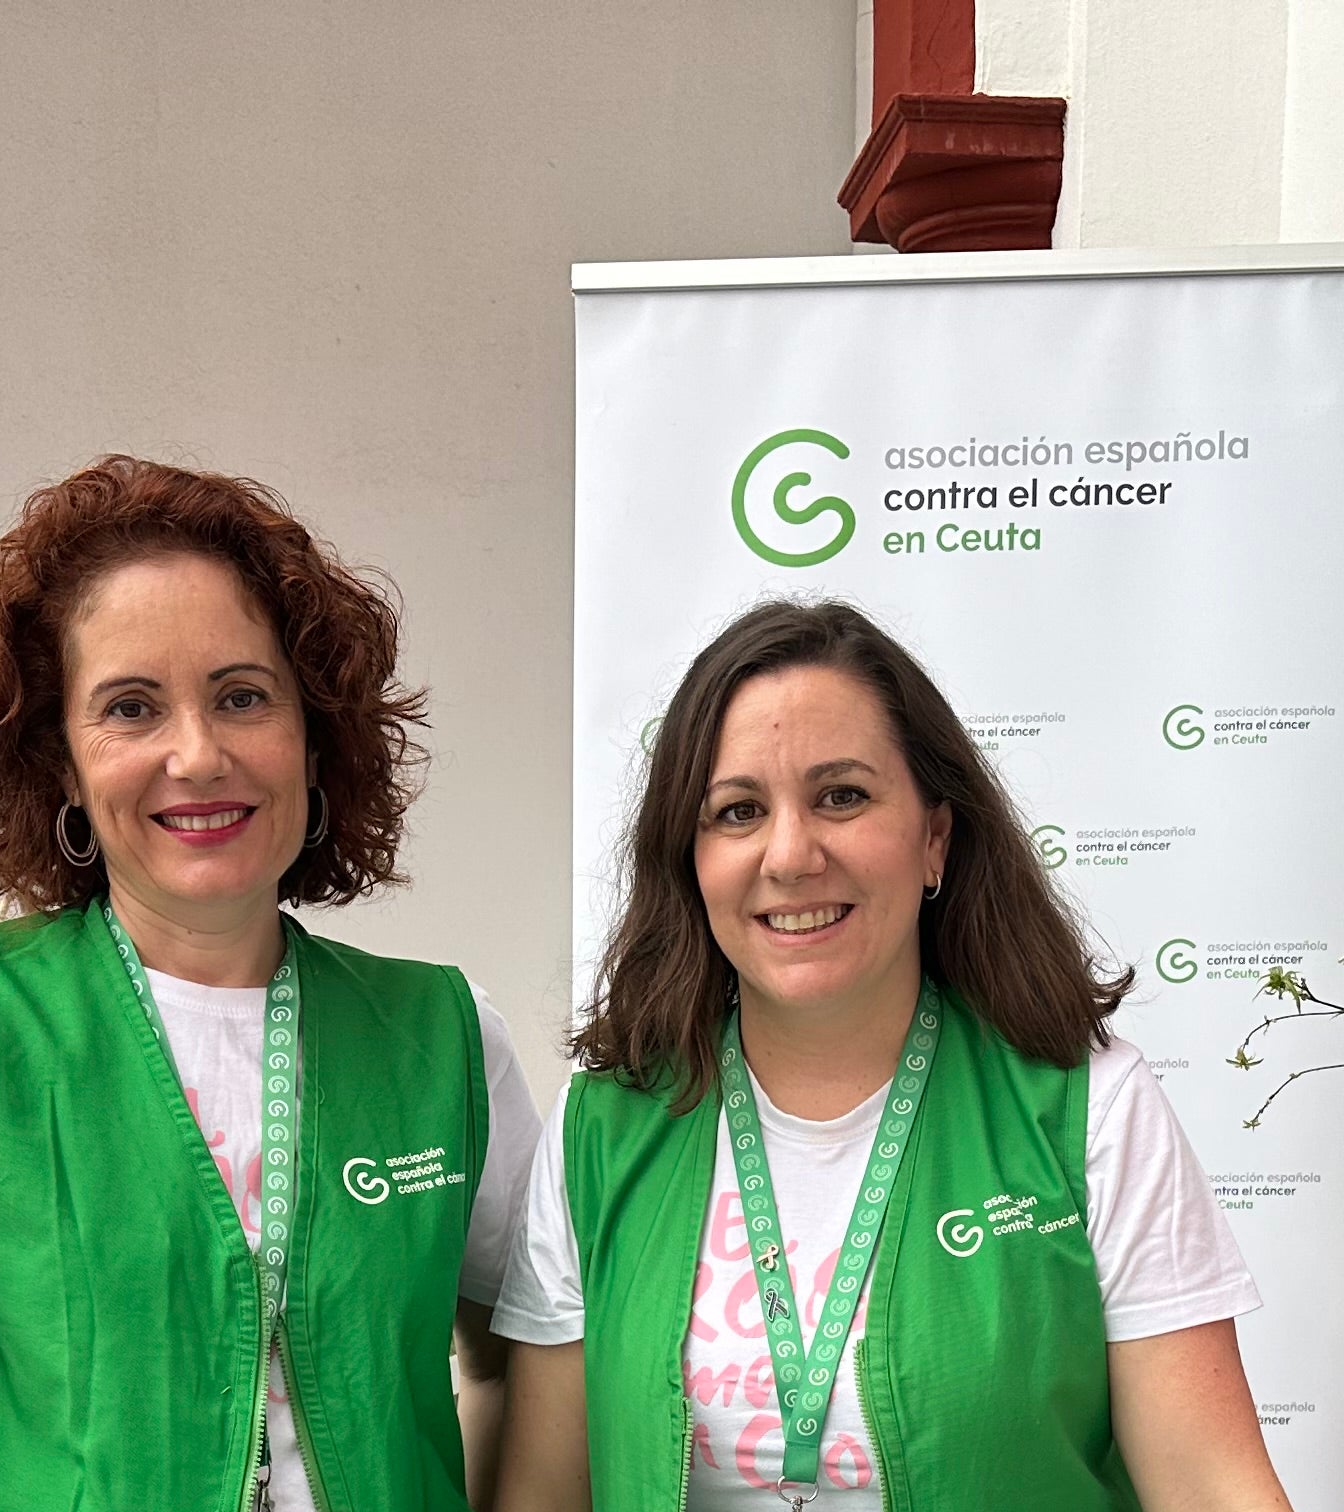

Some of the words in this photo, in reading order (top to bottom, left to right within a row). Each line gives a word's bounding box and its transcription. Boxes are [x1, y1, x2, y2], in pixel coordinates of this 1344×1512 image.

[884, 435, 1072, 469] asociación
[1085, 430, 1250, 470] española
[884, 482, 996, 512] contra
[1009, 478, 1037, 508] el
[1049, 476, 1172, 508] cáncer
[884, 529, 926, 555] en
[937, 523, 1042, 552] Ceuta
[1215, 706, 1277, 717] asociación
[1281, 705, 1335, 718] española
[961, 712, 1009, 723] ociación
[1012, 712, 1065, 724] española
[1214, 721, 1252, 731] contra
[1256, 720, 1266, 729] el
[1269, 719, 1310, 729] cáncer
[988, 727, 997, 736] el
[1001, 727, 1041, 736] cáncer
[1214, 736, 1228, 745] en
[1232, 734, 1267, 744] Ceuta
[1077, 829, 1138, 839] asociación
[1142, 826, 1196, 839] española
[1076, 842, 1114, 852] contra
[1117, 841, 1127, 851] el
[1130, 841, 1171, 851] cáncer
[1076, 857, 1090, 865] en
[1093, 856, 1128, 865] Ceuta
[1207, 941, 1270, 952] asociación
[1274, 940, 1327, 952] española
[1207, 956, 1245, 965] contra
[1249, 955, 1259, 964] el
[1262, 954, 1302, 964] cáncer
[1207, 970, 1221, 979] en
[1225, 968, 1260, 978] Ceuta
[386, 1147, 445, 1167] asociación
[392, 1163, 443, 1181] española
[1209, 1173, 1263, 1182] sociación
[1267, 1172, 1321, 1184] española
[398, 1178, 434, 1194] contra
[435, 1174, 446, 1186] el
[1215, 1187, 1238, 1195] ntra
[1242, 1186, 1252, 1195] el
[1255, 1186, 1295, 1195] cáncer
[1218, 1200, 1253, 1209] Ceuta
[993, 1219, 1034, 1236] contra
[1038, 1212, 1079, 1234] cáncer
[1261, 1402, 1315, 1413] española
